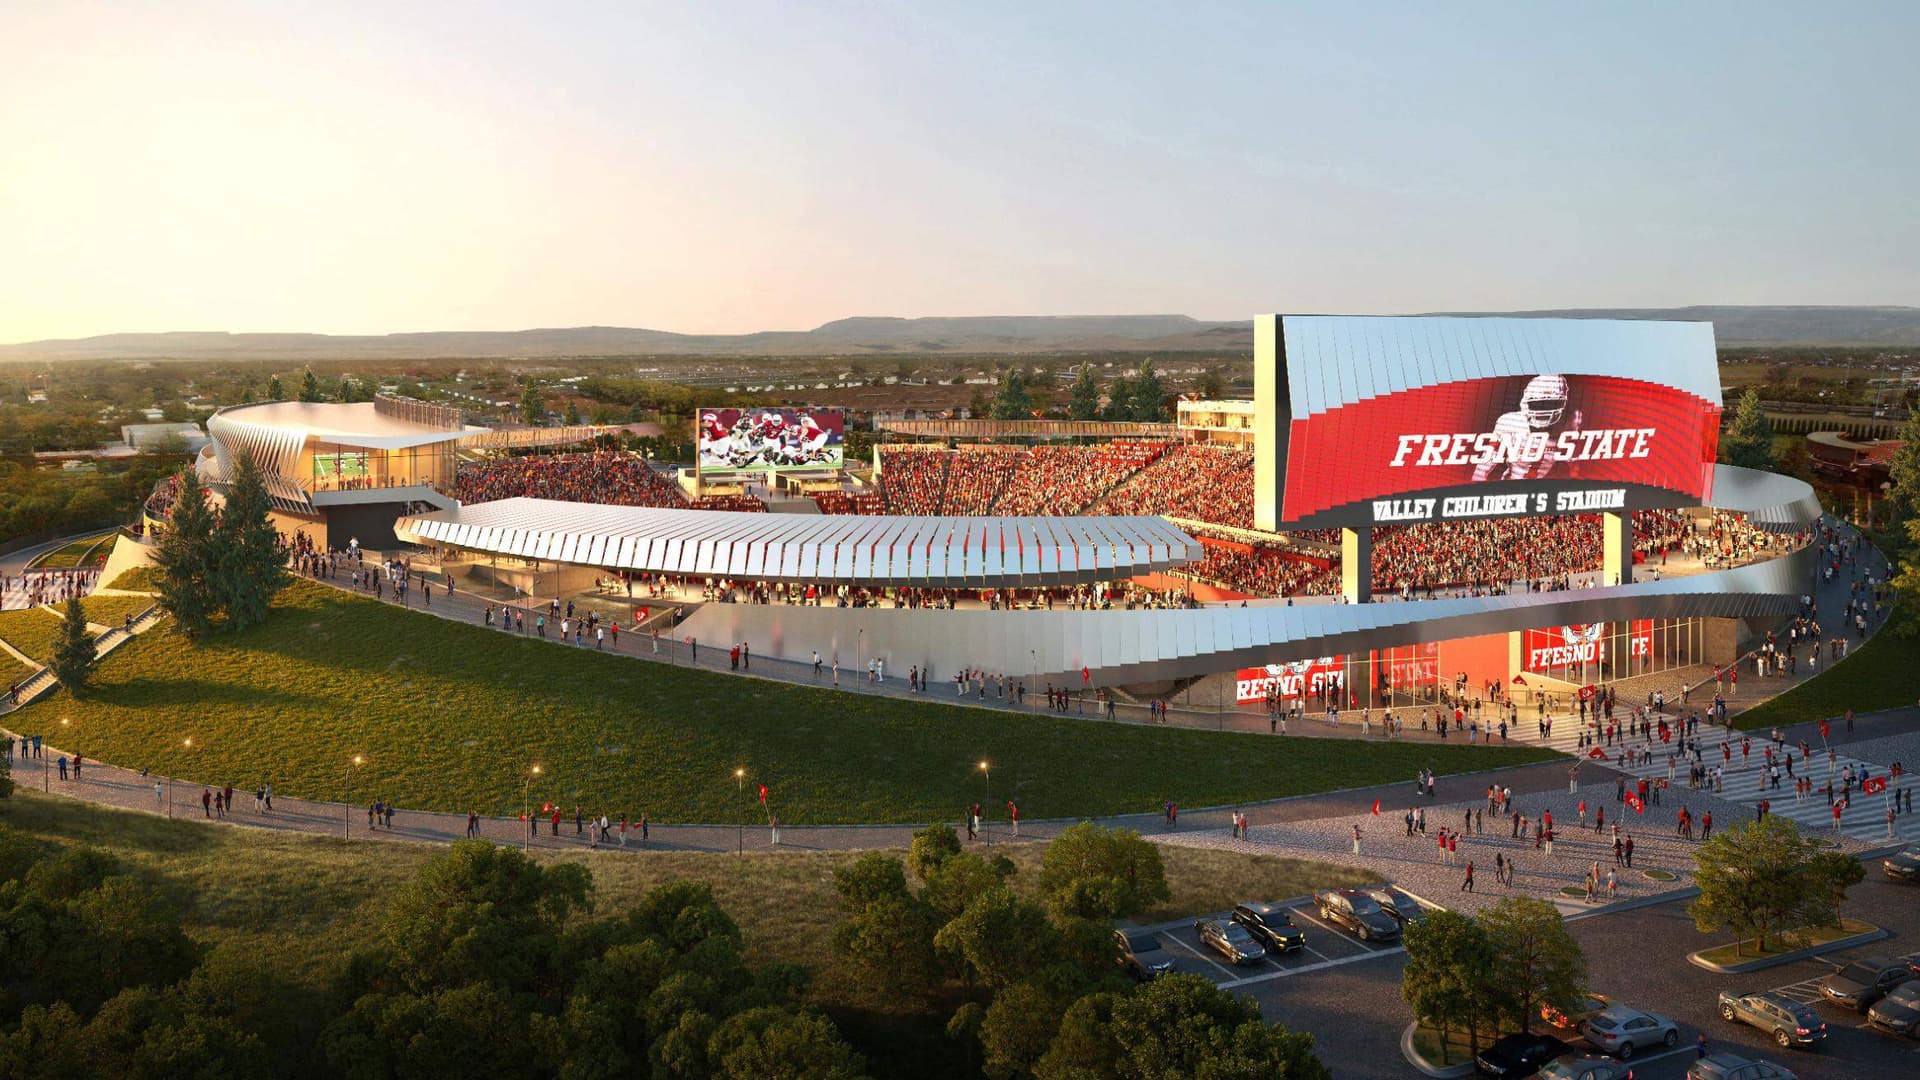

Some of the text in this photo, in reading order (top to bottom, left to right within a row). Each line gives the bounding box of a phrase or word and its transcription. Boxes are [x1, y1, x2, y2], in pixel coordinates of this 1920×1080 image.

[1389, 428, 1656, 467] FRESNO STATE
[1372, 498, 1437, 521] VALLEY
[1556, 489, 1626, 511] STADIUM
[1529, 642, 1596, 668] FRESNO
